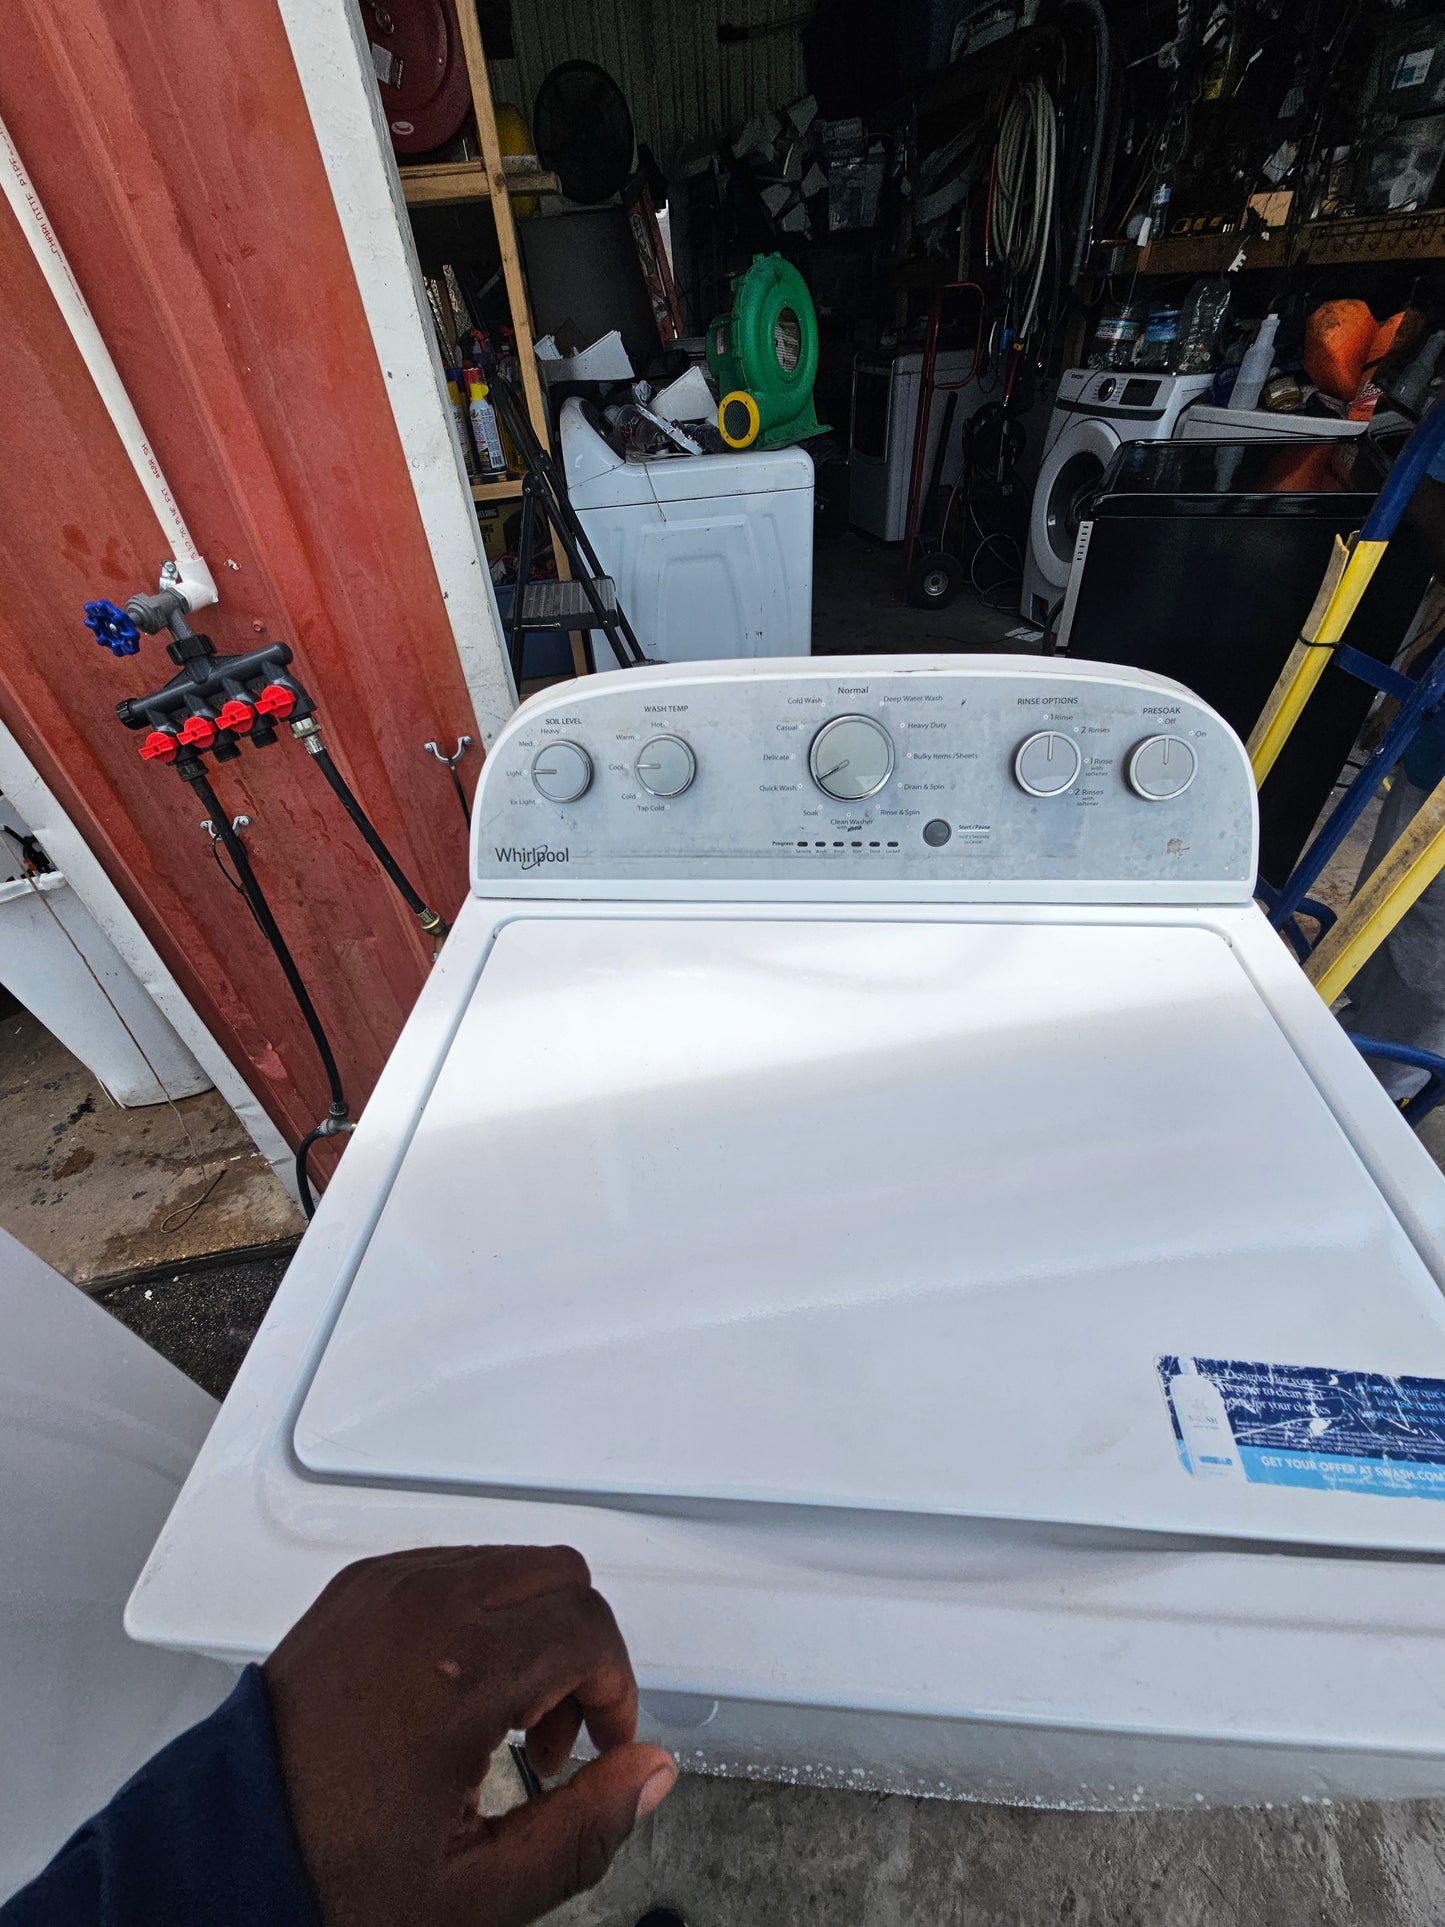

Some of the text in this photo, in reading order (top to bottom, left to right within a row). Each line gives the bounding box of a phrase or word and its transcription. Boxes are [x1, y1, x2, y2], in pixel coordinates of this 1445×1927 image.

[837, 686, 869, 694] Normal
[883, 695, 902, 703] Deep
[1042, 697, 1079, 705] OPTIONS
[644, 705, 667, 713] WASH
[1142, 707, 1181, 715] PRESOAK
[930, 783, 945, 791] Spin
[495, 846, 569, 869] Whirlpool
[1263, 1387, 1274, 1396] to
[1275, 1388, 1302, 1399] clean
[1260, 1456, 1282, 1467] GET
[1284, 1458, 1318, 1470] YOUR
[1318, 1461, 1357, 1474] OFFER
[1360, 1465, 1372, 1476] AT
